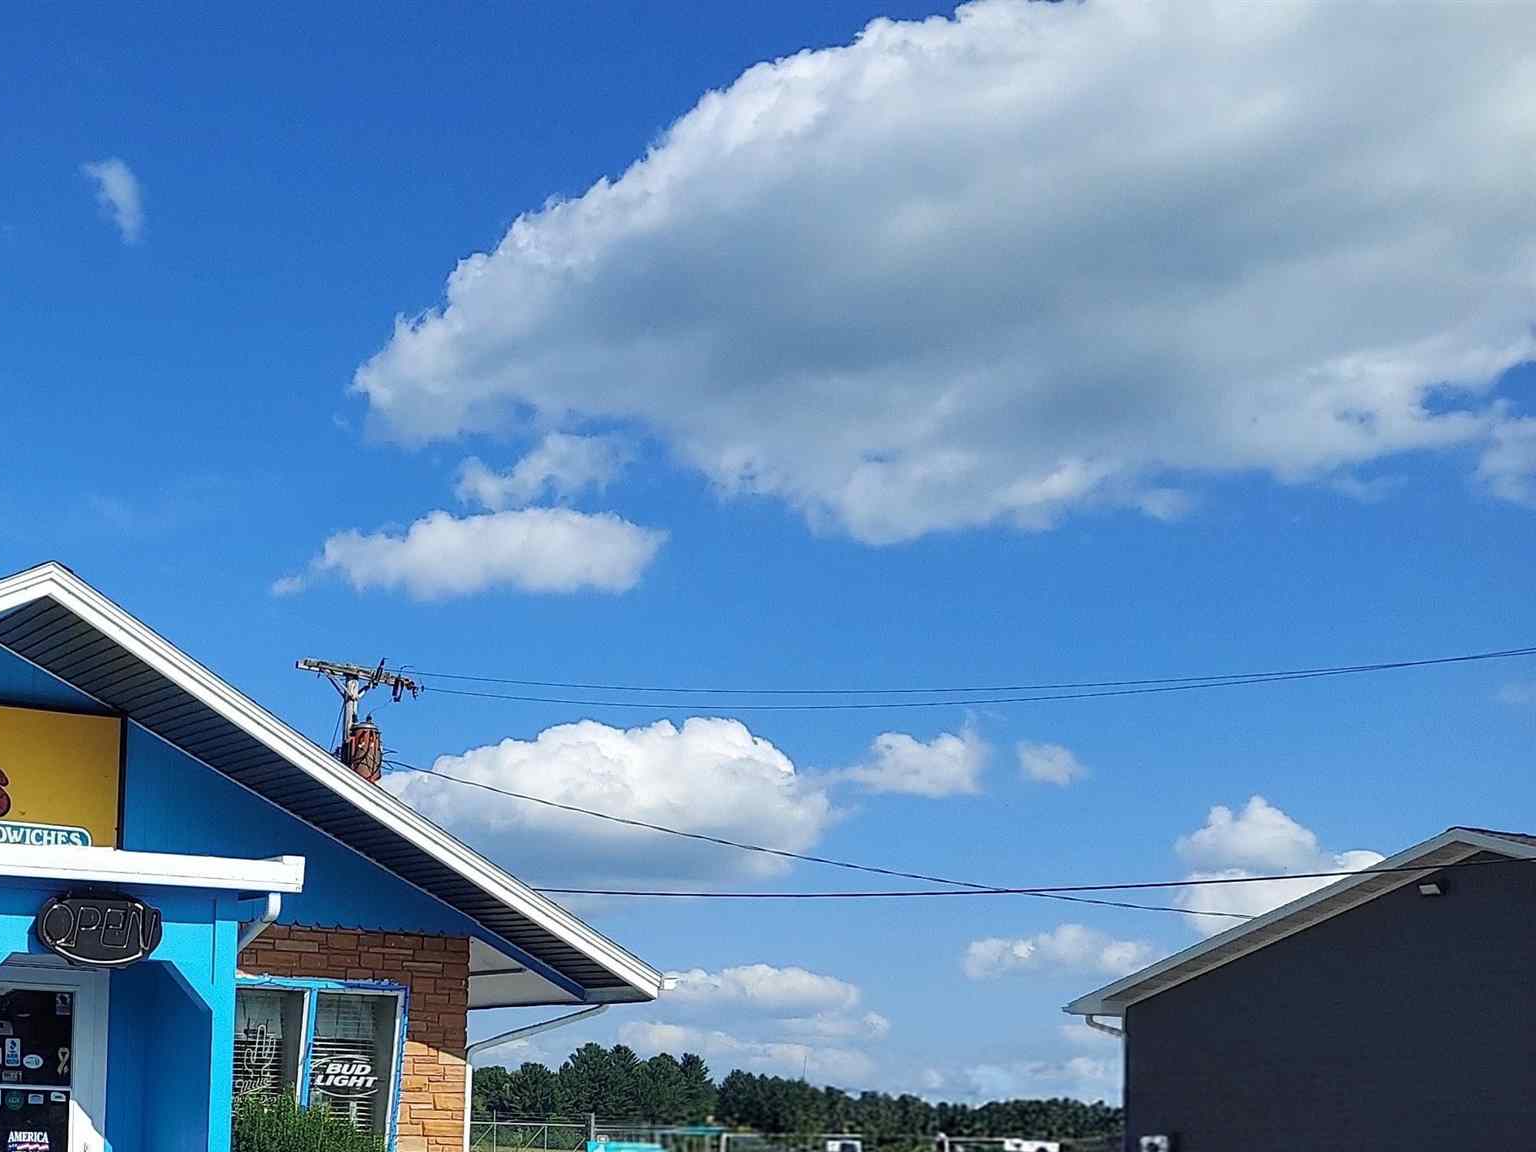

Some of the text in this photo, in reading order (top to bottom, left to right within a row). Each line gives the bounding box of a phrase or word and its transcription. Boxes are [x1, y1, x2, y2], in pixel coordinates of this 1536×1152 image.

[42, 902, 158, 951] OPEN
[325, 1062, 372, 1076] BUD
[314, 1075, 378, 1088] LIGHT
[8, 1131, 49, 1143] AMERICA
